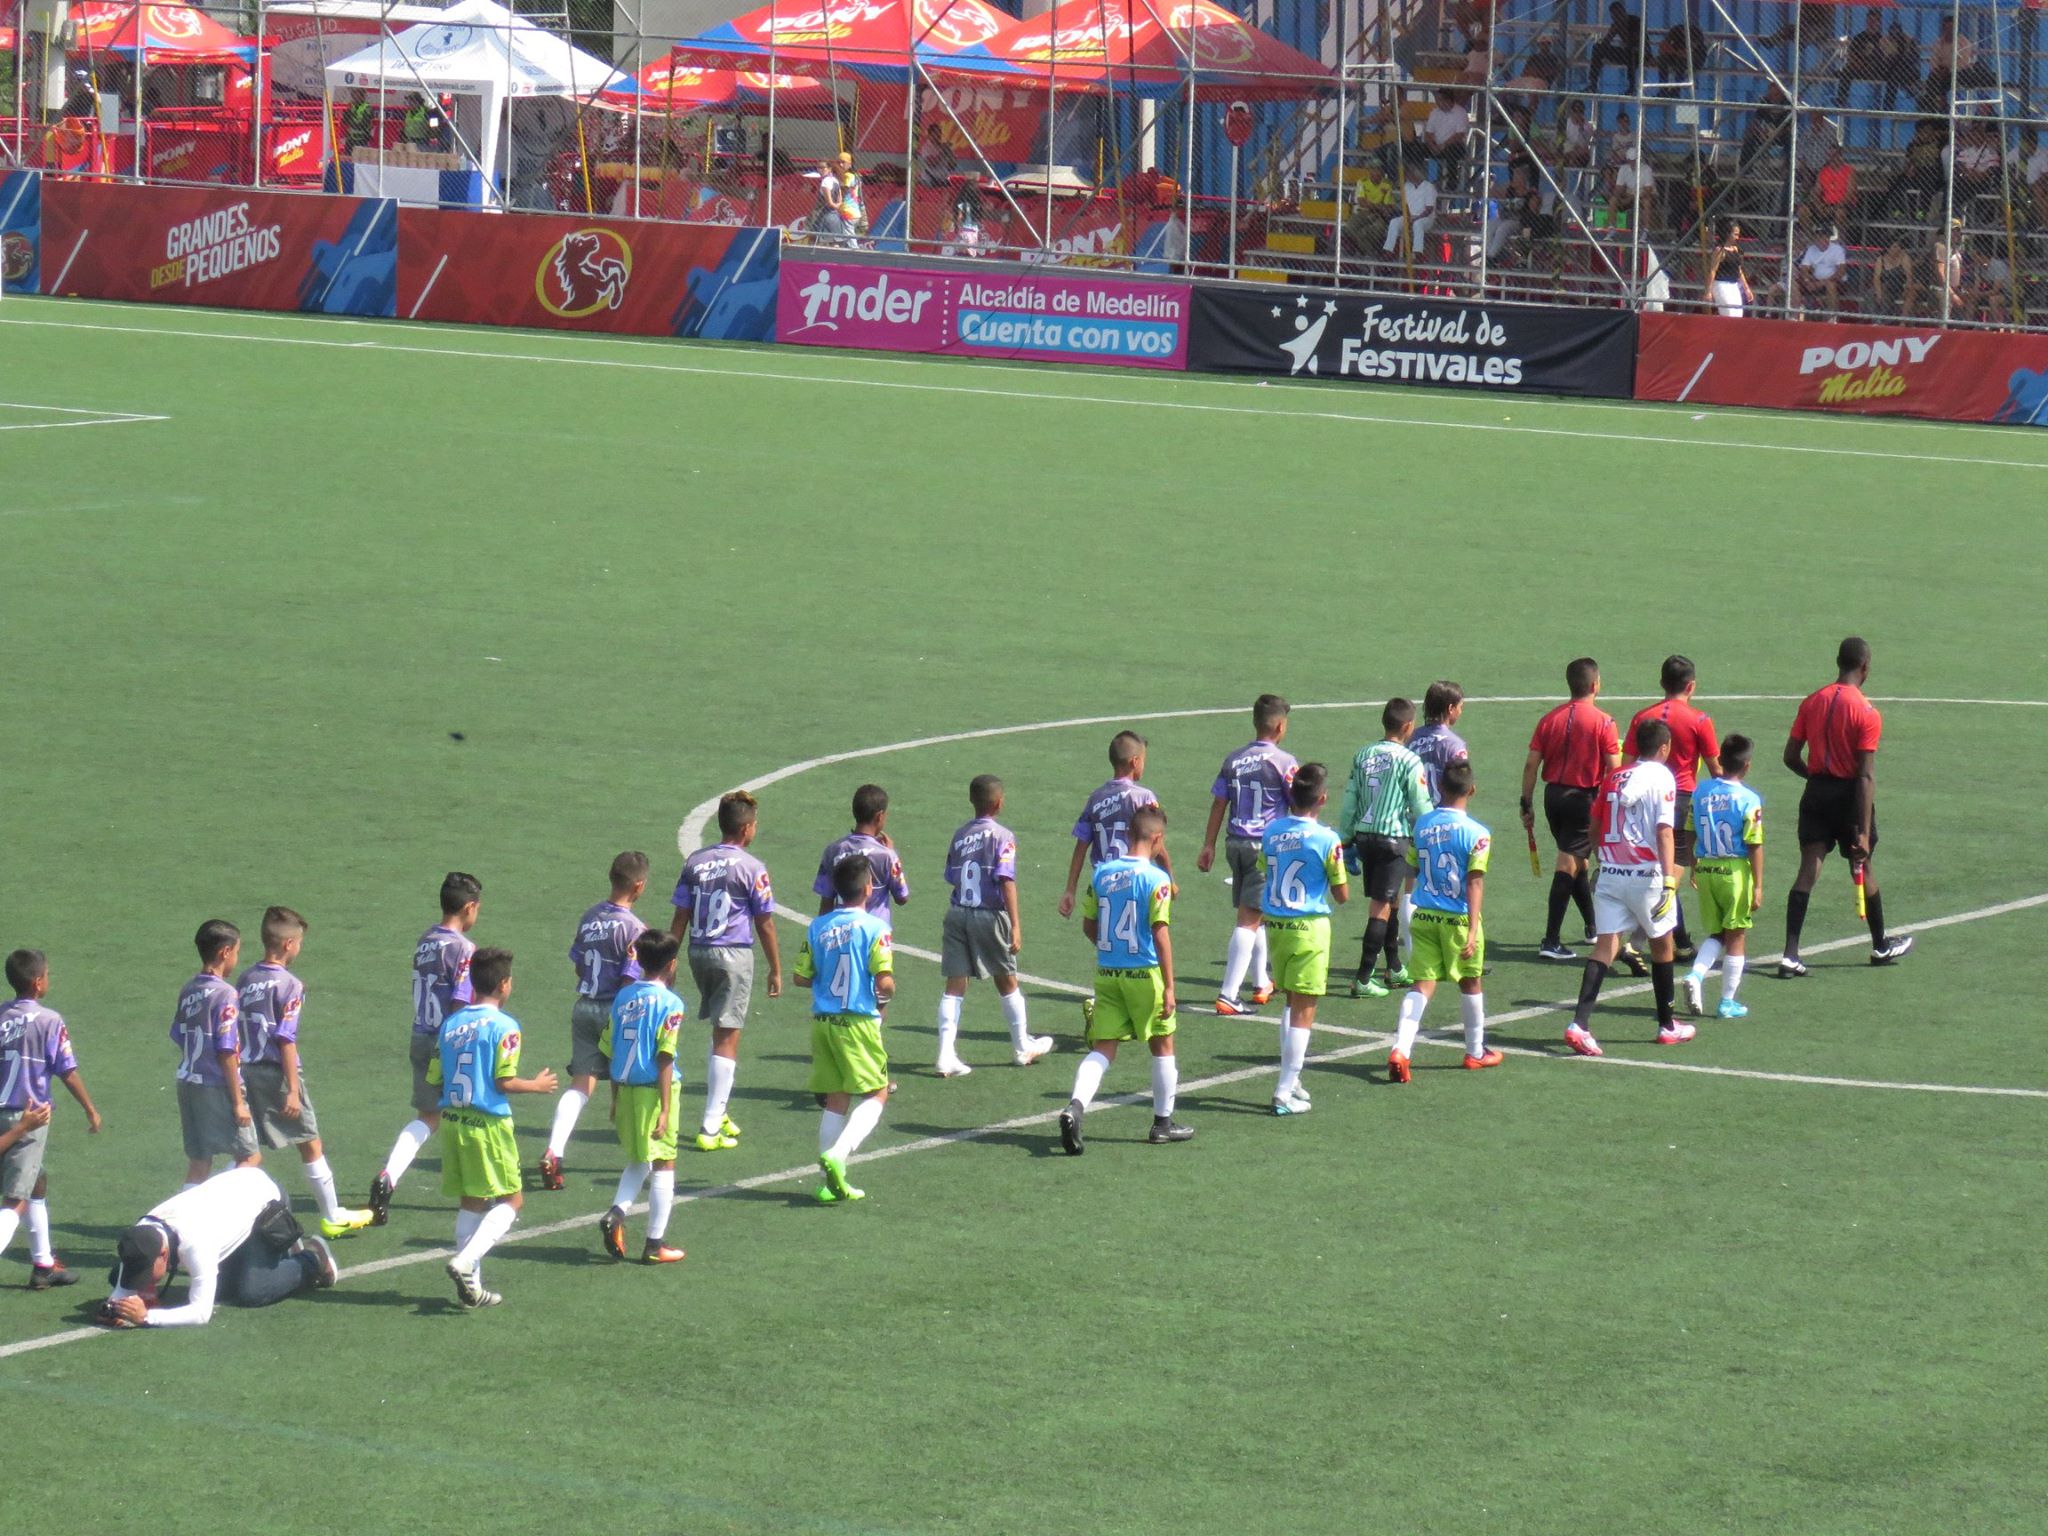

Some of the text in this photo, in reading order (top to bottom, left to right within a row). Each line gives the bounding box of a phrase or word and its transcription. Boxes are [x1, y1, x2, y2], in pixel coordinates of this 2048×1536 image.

[757, 1, 898, 32] PONY
[1010, 18, 1153, 51] PONY
[273, 130, 311, 158] PONY
[167, 202, 249, 260] GRANDES
[150, 225, 281, 289] DESDE PEQUEÑOS
[958, 282, 1180, 319] Alcaldía de Medellín
[961, 313, 1174, 355] Cuenta con vos
[1362, 304, 1507, 347] Festival de
[1800, 335, 1942, 375] PONY
[1818, 366, 1907, 404] Malta
[1231, 752, 1275, 770] PONY
[1092, 789, 1132, 814] PONY
[1231, 778, 1266, 828] 11
[955, 829, 994, 851] PONY
[1269, 830, 1314, 845] PONY
[693, 858, 742, 875] PONY
[1267, 855, 1306, 910] 16
[1418, 848, 1461, 900] 13
[1602, 866, 1634, 878] PONY
[691, 885, 732, 939] 18
[1098, 896, 1138, 953] 14
[1413, 912, 1444, 924] PONY
[829, 953, 850, 1009] 4
[0, 1011, 40, 1032] ONY
[620, 1028, 639, 1083] 7
[450, 1051, 473, 1108] 5
